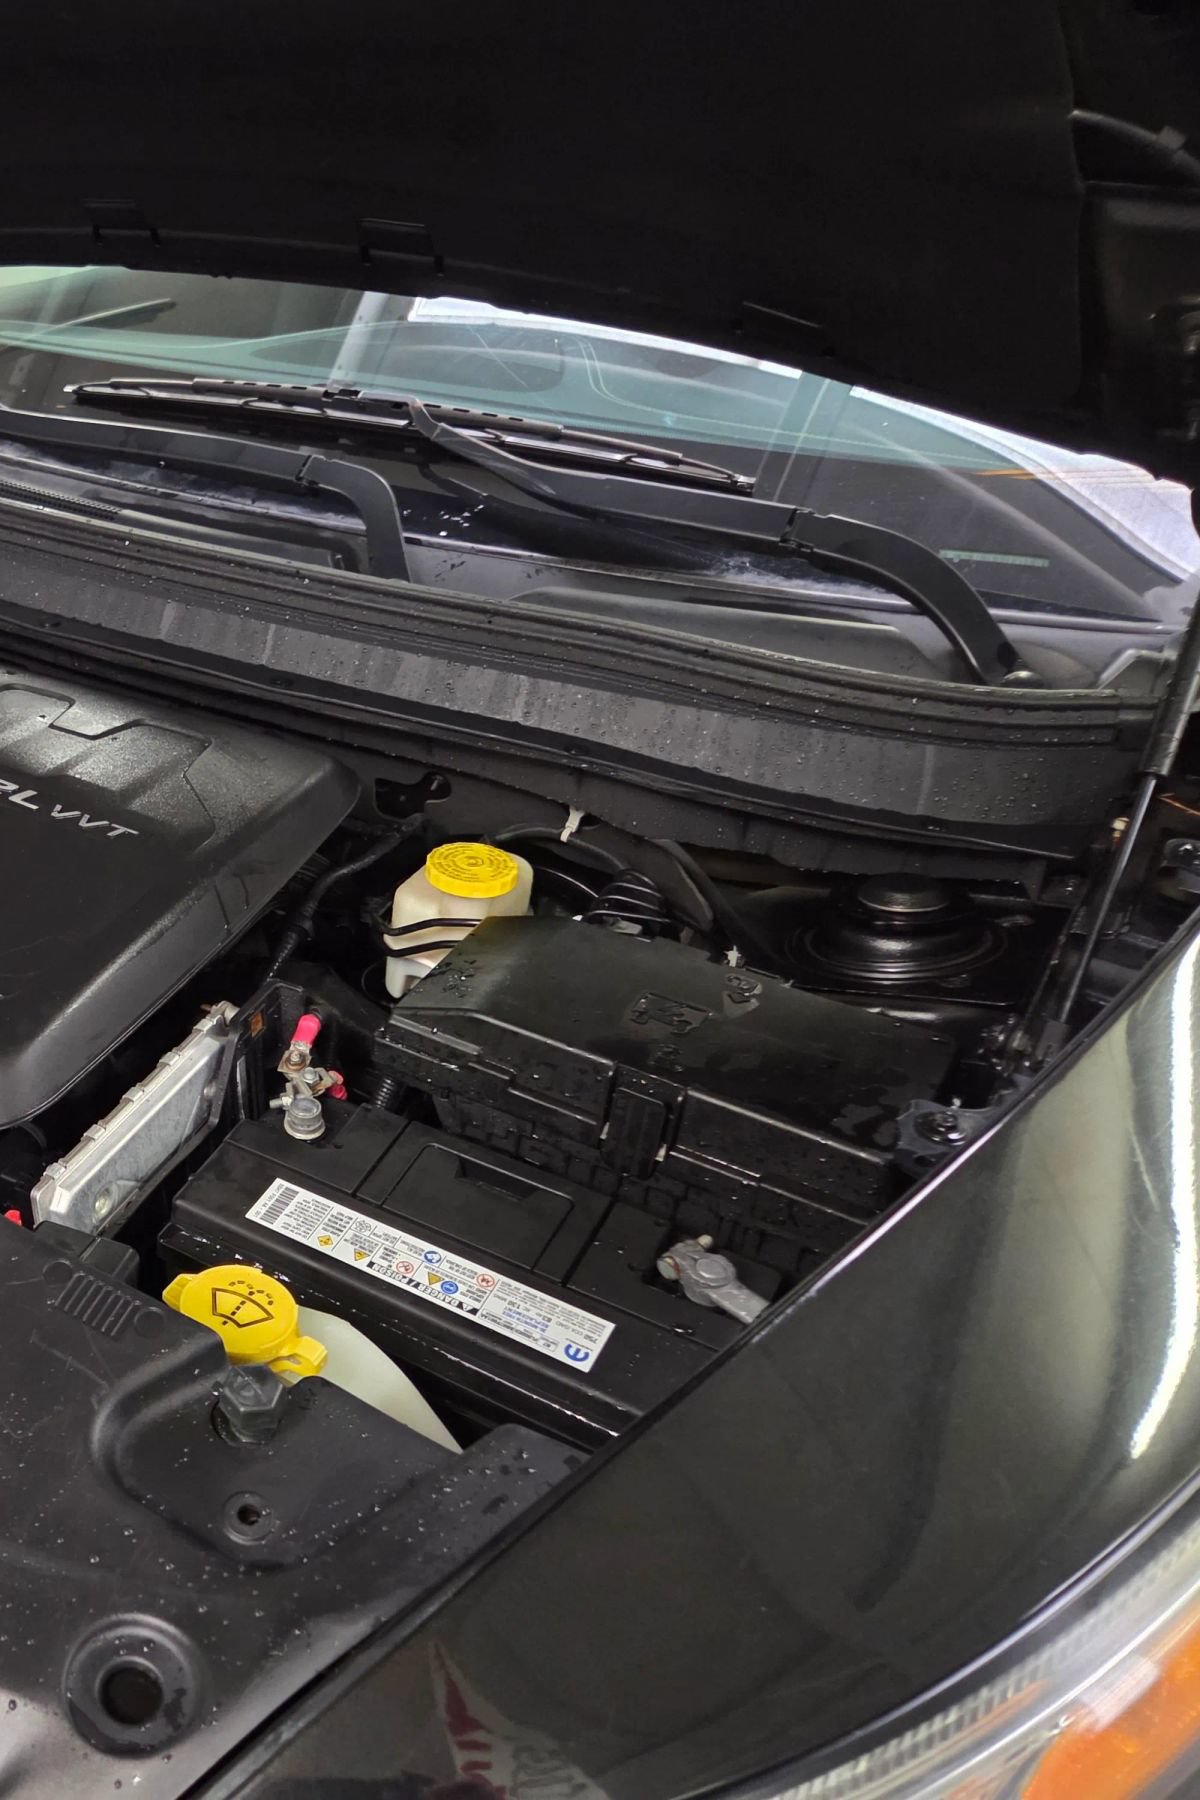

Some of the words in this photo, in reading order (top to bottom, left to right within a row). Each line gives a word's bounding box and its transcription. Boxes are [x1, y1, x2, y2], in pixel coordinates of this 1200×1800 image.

[50, 804, 139, 837] VVT
[370, 1262, 410, 1284] POISON
[416, 1282, 460, 1307] DANGER
